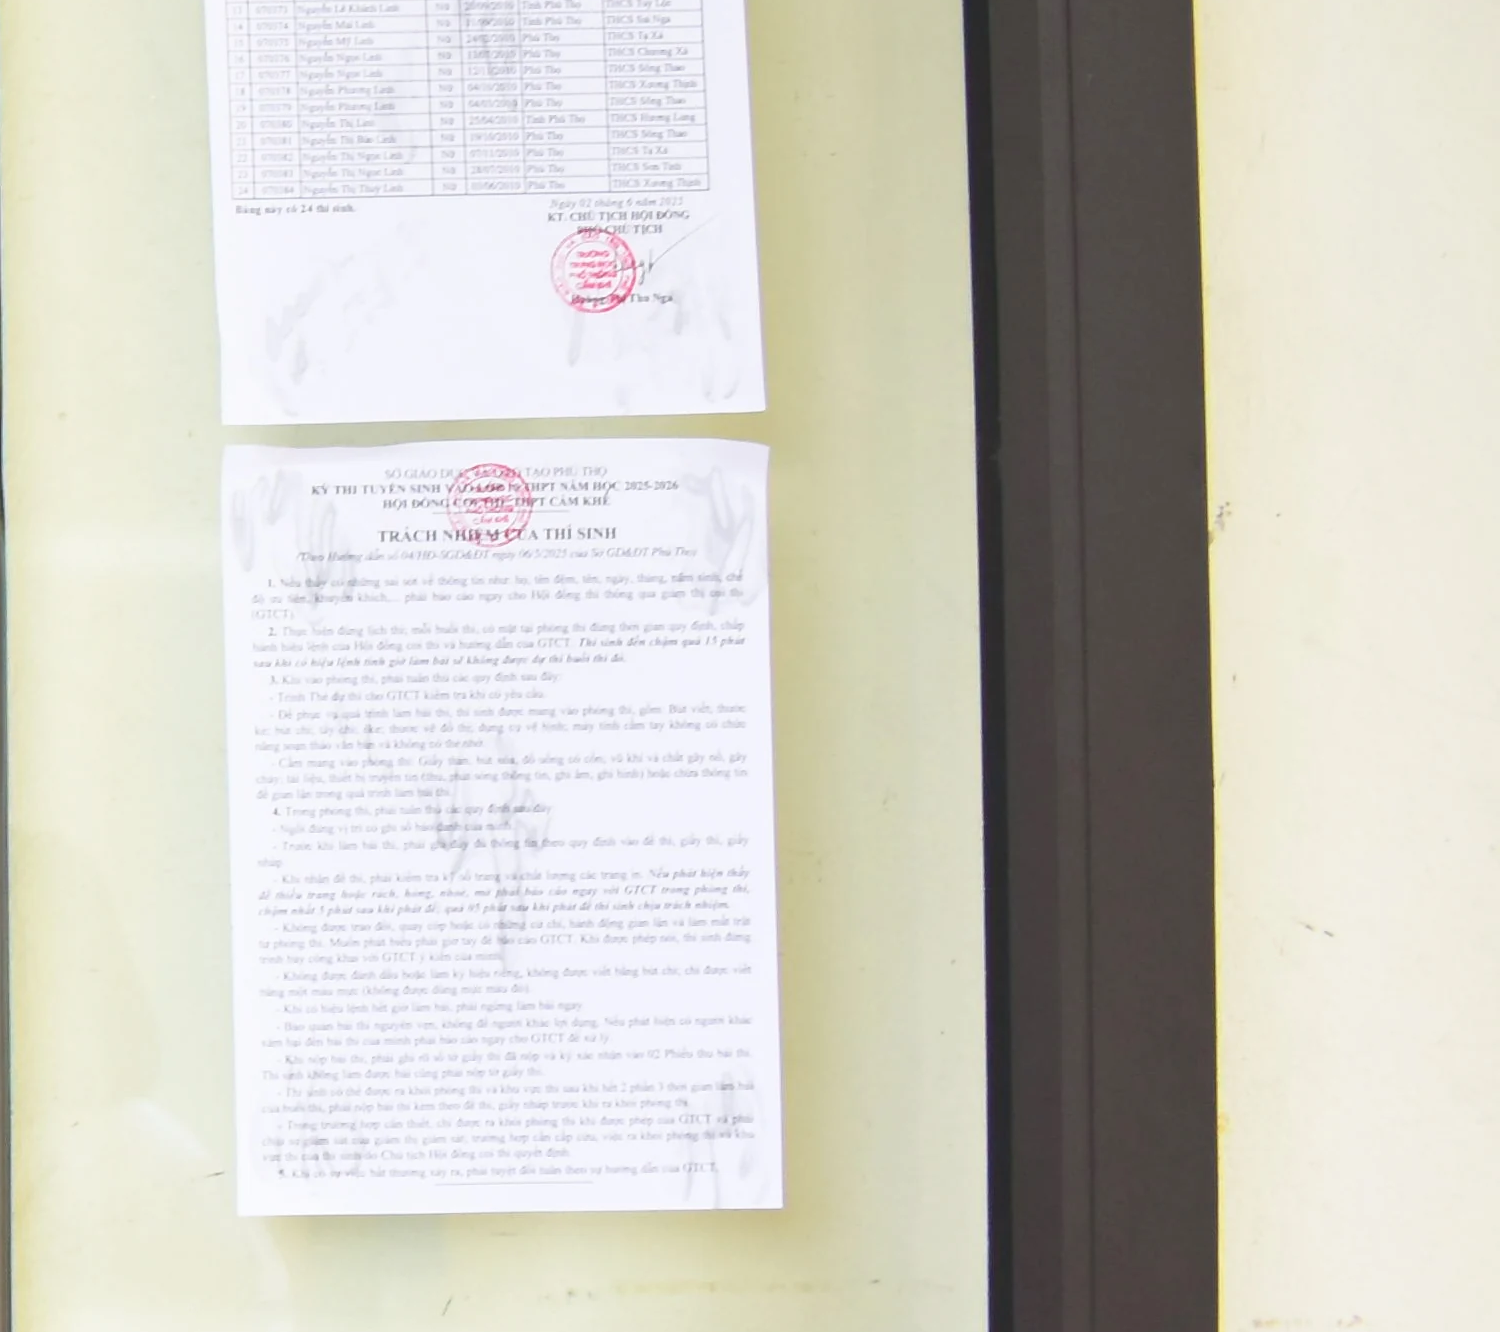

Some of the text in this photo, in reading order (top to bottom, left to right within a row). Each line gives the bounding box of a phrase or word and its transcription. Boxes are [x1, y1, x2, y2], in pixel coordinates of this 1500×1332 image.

[312, 483, 328, 495] KỲ
[334, 485, 357, 495] THI
[363, 483, 406, 494] TUYỂN
[410, 484, 440, 494] SINH
[560, 479, 589, 491] NĂM
[593, 481, 620, 493] HỌC
[625, 480, 679, 491] 2025-2026
[383, 499, 407, 511] HỘI
[412, 496, 450, 510] ĐỒNG
[549, 495, 579, 506] CẨM
[583, 494, 609, 506] KHÊ
[378, 527, 436, 542] TRÁCH
[543, 524, 572, 540] THÍ
[577, 527, 616, 539] SINH
